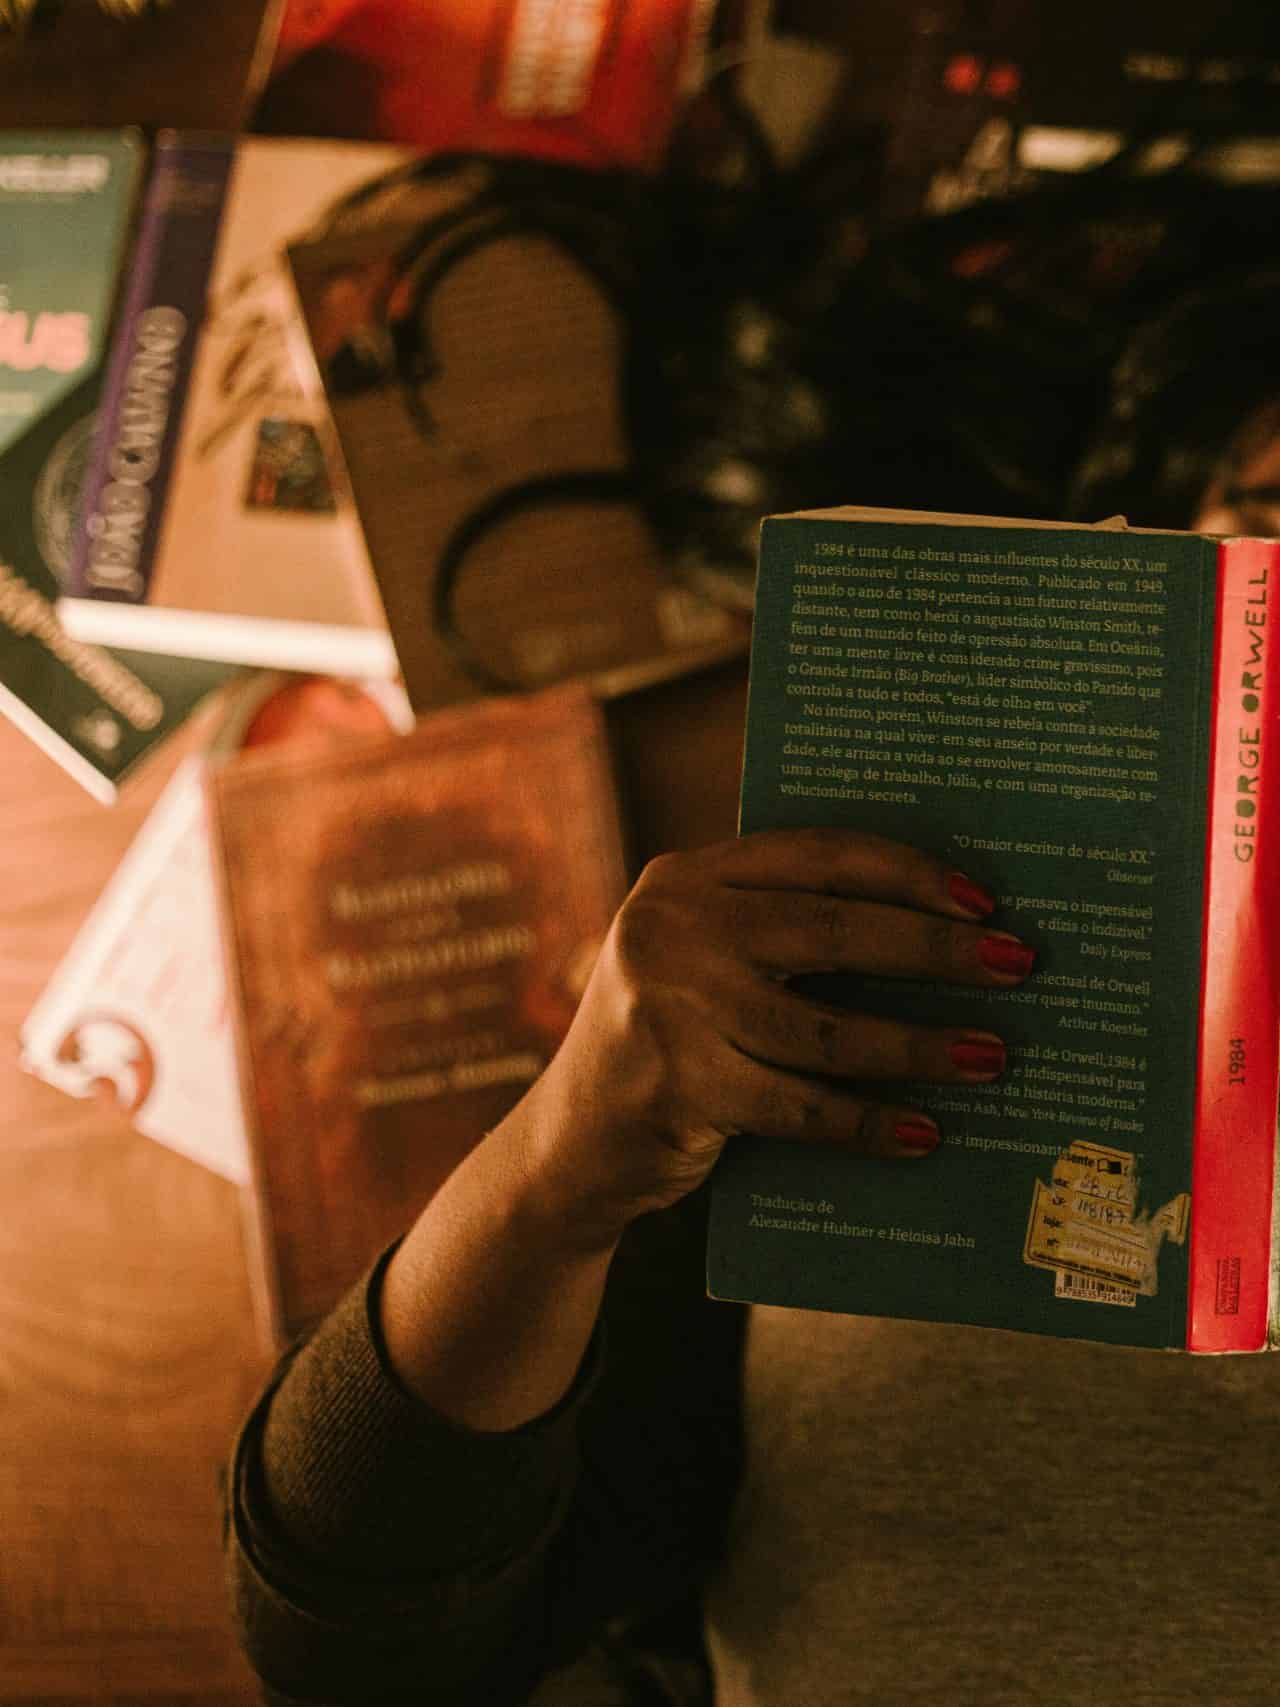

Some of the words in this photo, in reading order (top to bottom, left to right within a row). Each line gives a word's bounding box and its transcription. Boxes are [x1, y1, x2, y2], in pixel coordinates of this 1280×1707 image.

[1241, 568, 1268, 713] ORWELL
[1234, 727, 1260, 863] GEORGE
[1228, 1038, 1246, 1086] 1984
